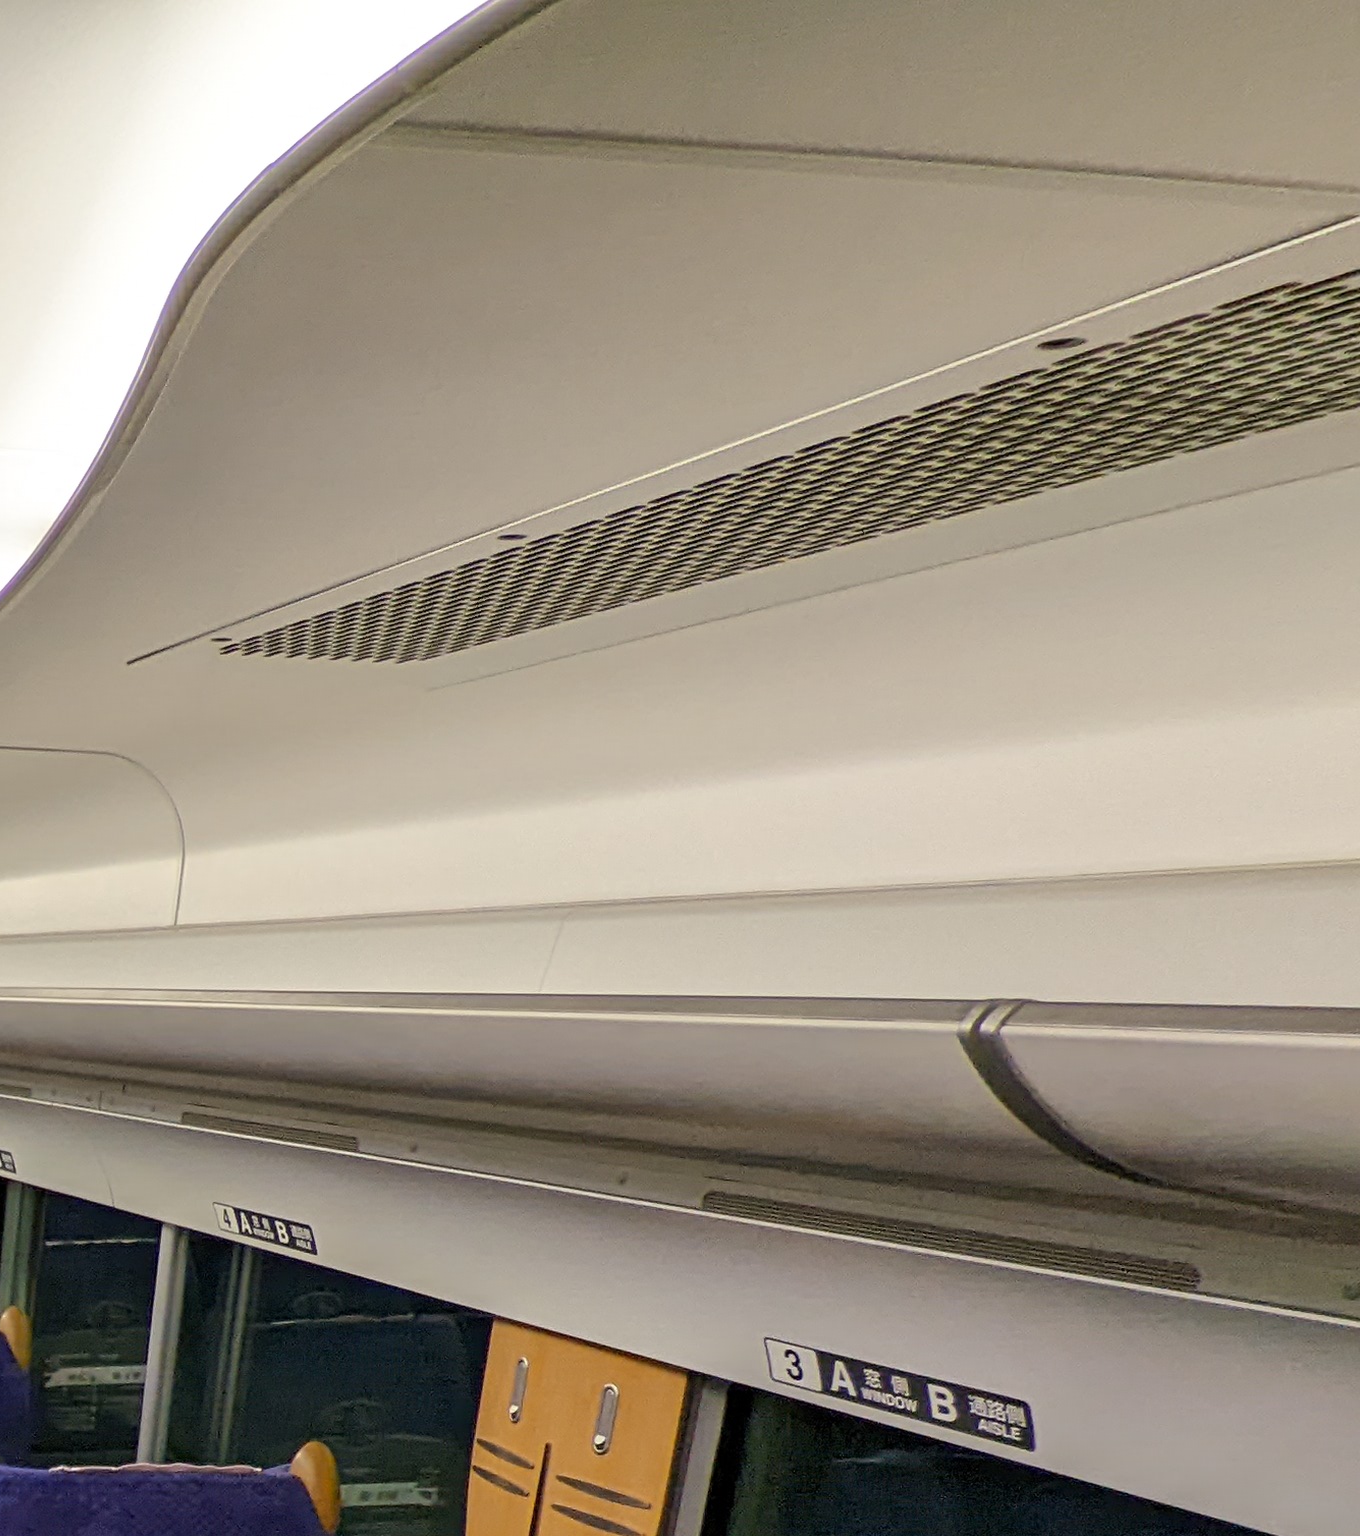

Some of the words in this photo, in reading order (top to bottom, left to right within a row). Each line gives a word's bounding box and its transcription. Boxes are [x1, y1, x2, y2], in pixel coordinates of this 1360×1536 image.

[222, 1208, 231, 1229] 4
[240, 1212, 252, 1235] A
[275, 1220, 289, 1244] B
[783, 1349, 803, 1381] 3
[830, 1361, 857, 1397] A
[863, 1368, 911, 1397] 窓側
[927, 1383, 958, 1422] B
[968, 1395, 1026, 1428] 通路側
[861, 1388, 918, 1413] WINDOW
[977, 1419, 1022, 1440] AISLE
